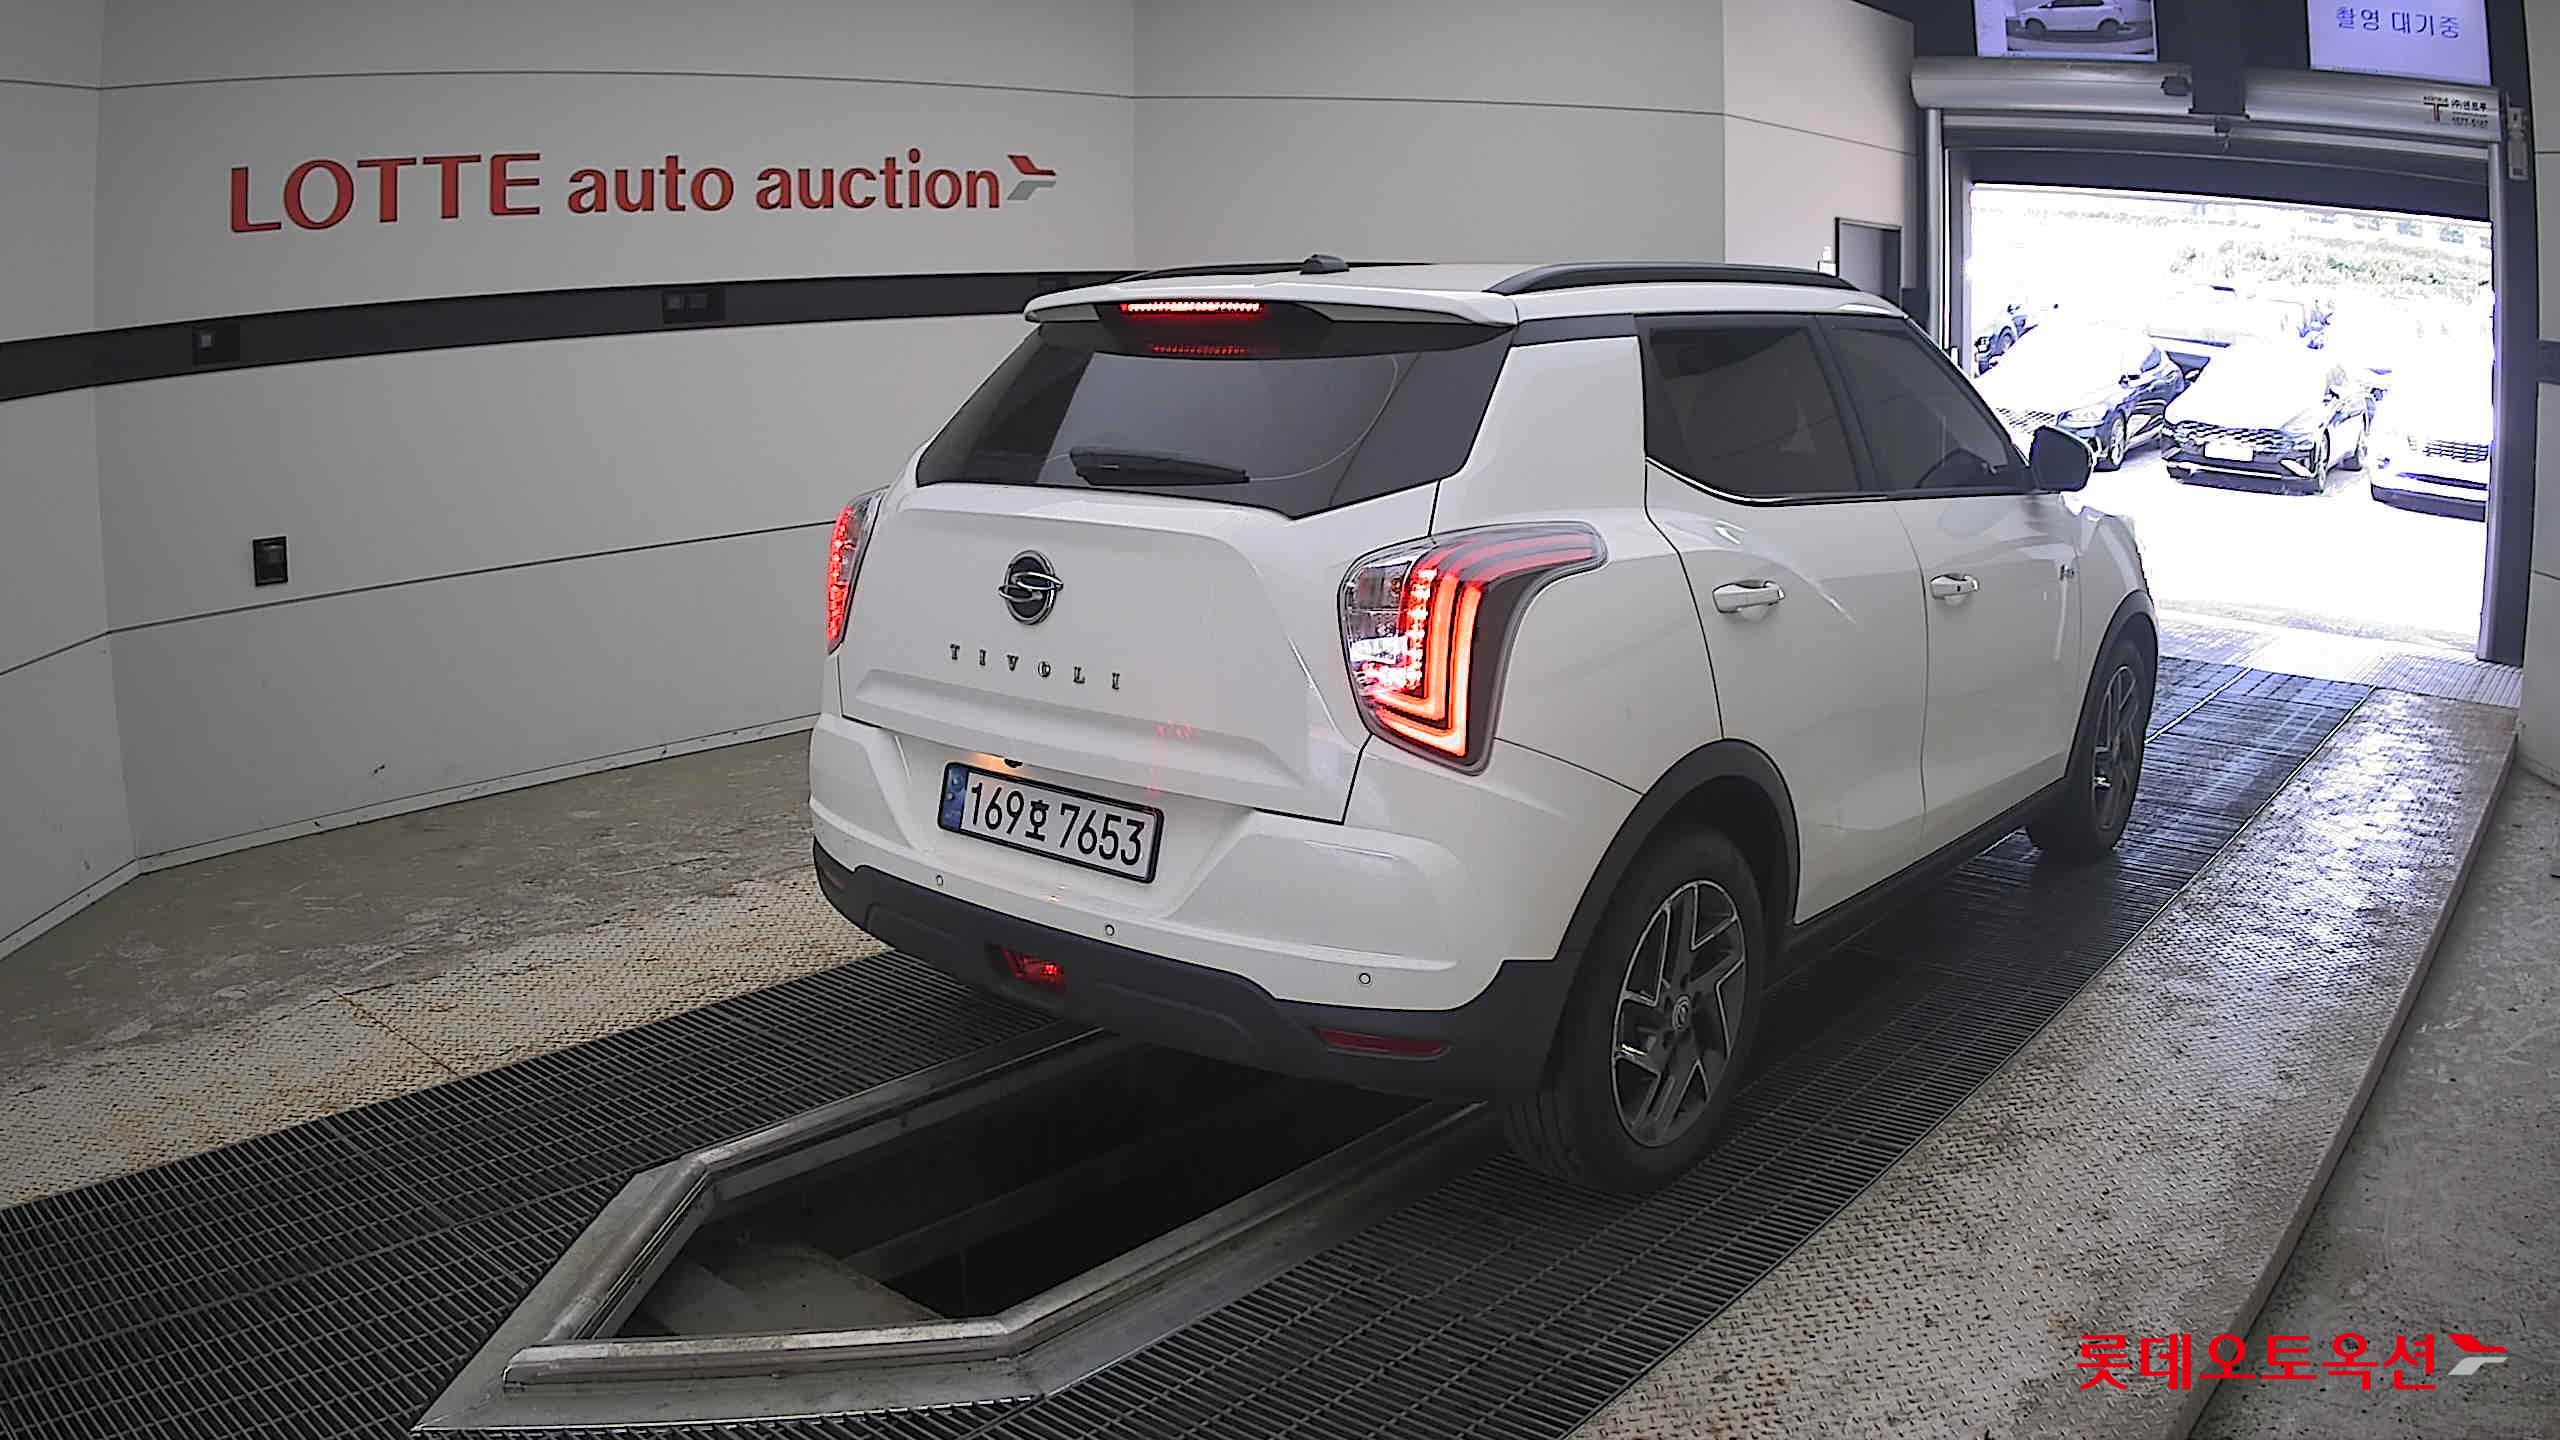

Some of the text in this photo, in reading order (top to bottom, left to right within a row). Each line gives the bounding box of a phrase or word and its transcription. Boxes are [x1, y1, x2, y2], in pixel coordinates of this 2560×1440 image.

[2337, 6, 2460, 39] 촬영 대기중
[229, 148, 1001, 234] LOTTE auto auction
[950, 643, 1121, 691] TIVOLI
[971, 782, 1146, 866] 169호 7653
